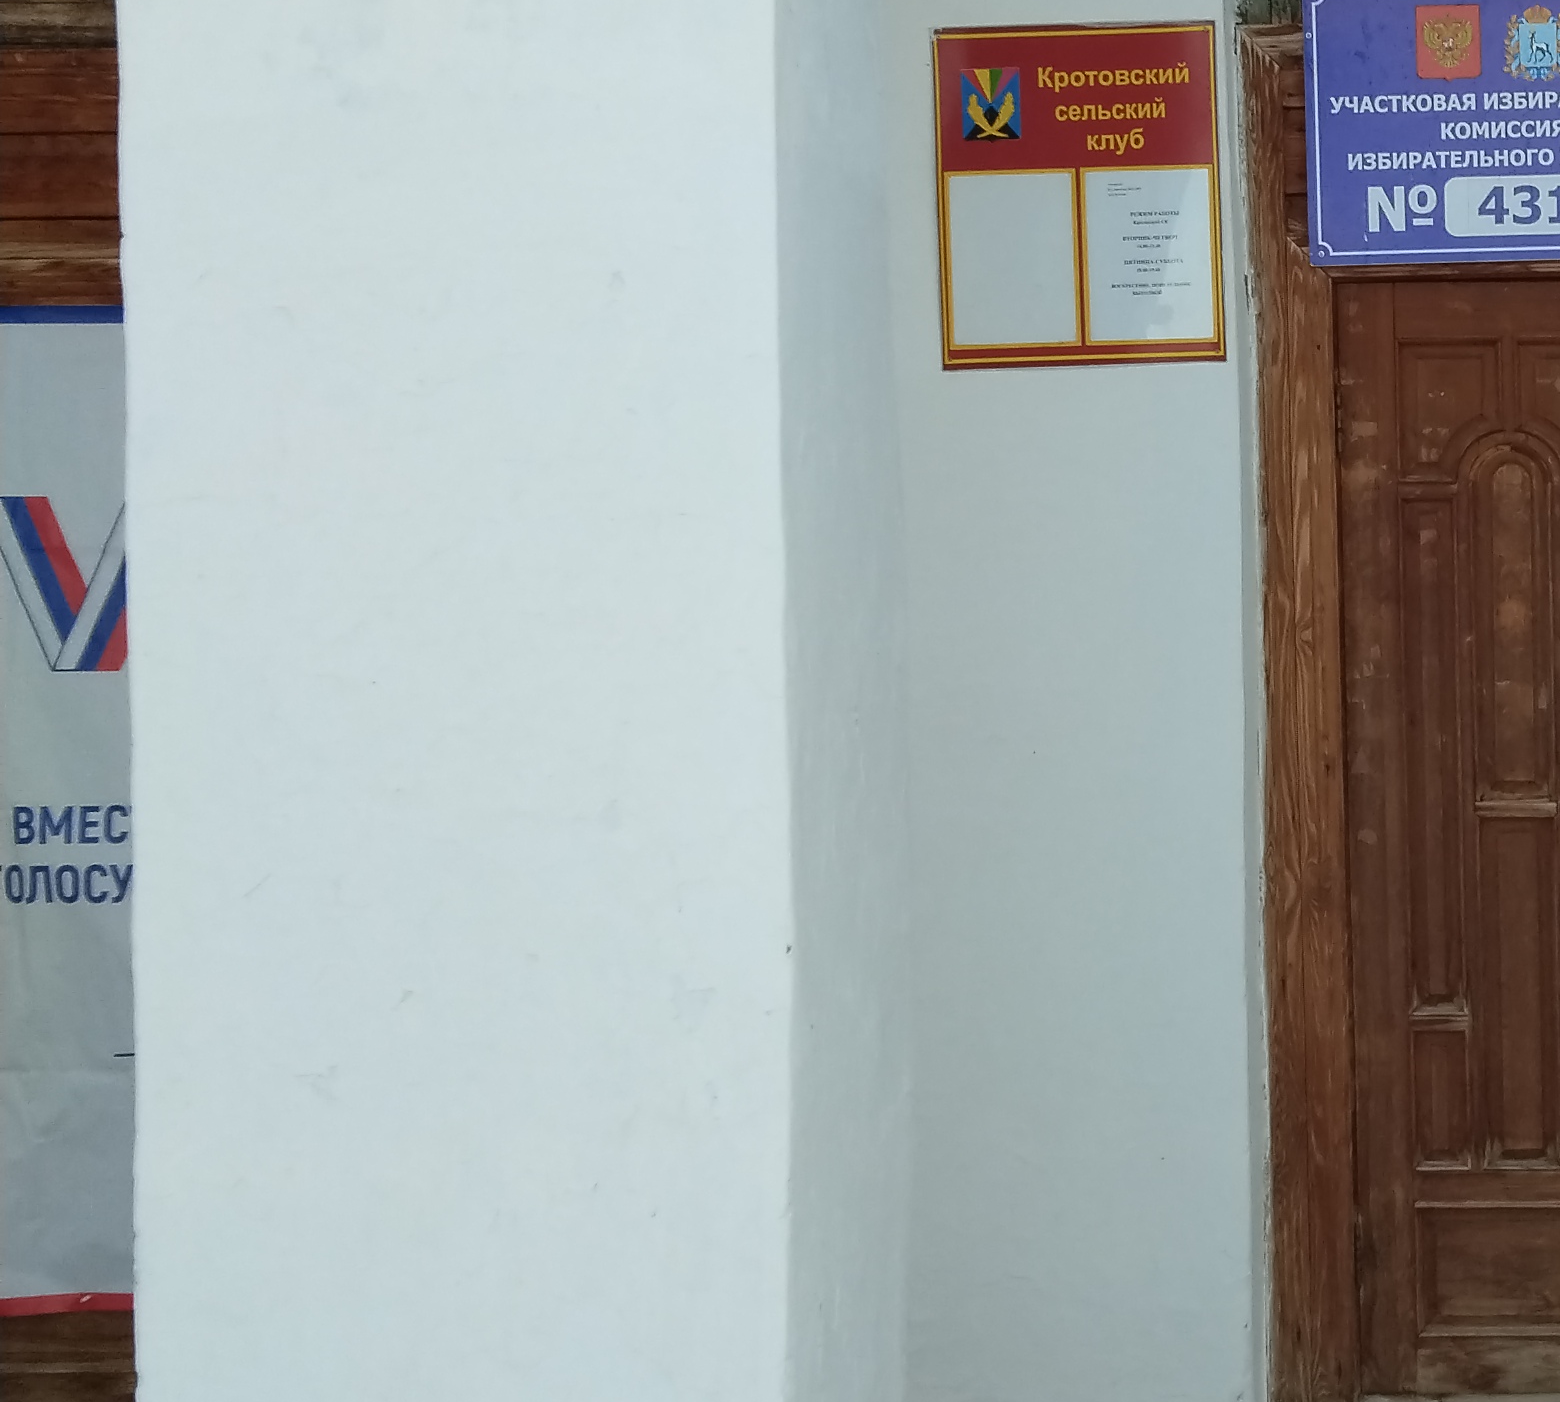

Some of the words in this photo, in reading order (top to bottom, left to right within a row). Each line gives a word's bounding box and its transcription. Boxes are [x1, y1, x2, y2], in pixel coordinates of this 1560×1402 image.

[1037, 62, 1190, 92] Кротовский
[1055, 97, 1166, 122] сельский
[1330, 93, 1476, 114] УЧАСТКОВАЯ
[1087, 128, 1145, 155] клуб
[1347, 147, 1554, 171] ИЗБИРАТЕЛЬНОГО
[13, 805, 132, 845] ВМЕС
[0, 864, 133, 904] ОЛОСУ
